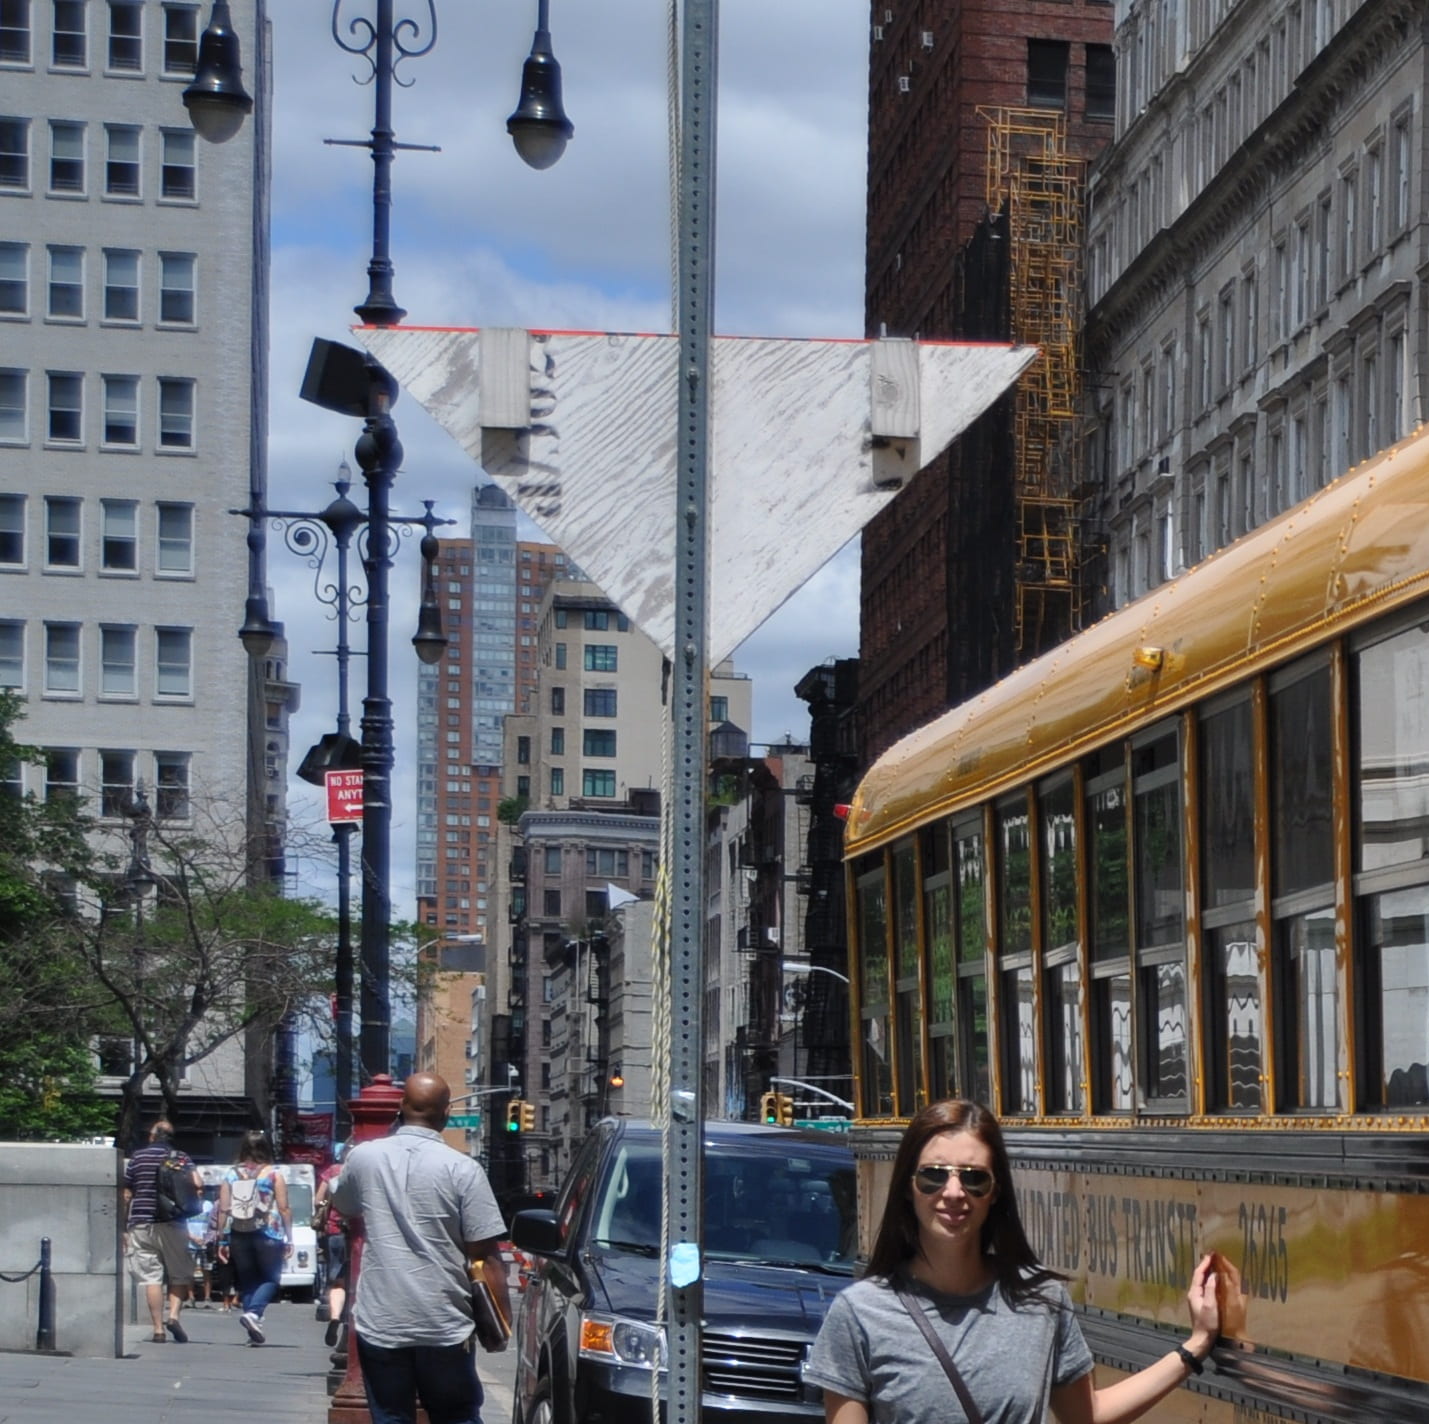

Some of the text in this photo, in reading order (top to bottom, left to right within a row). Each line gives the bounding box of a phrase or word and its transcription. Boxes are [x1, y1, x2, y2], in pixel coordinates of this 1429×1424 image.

[330, 776, 342, 787] NO
[1087, 1194, 1118, 1278] BUS
[1238, 1201, 1289, 1304] 26265
